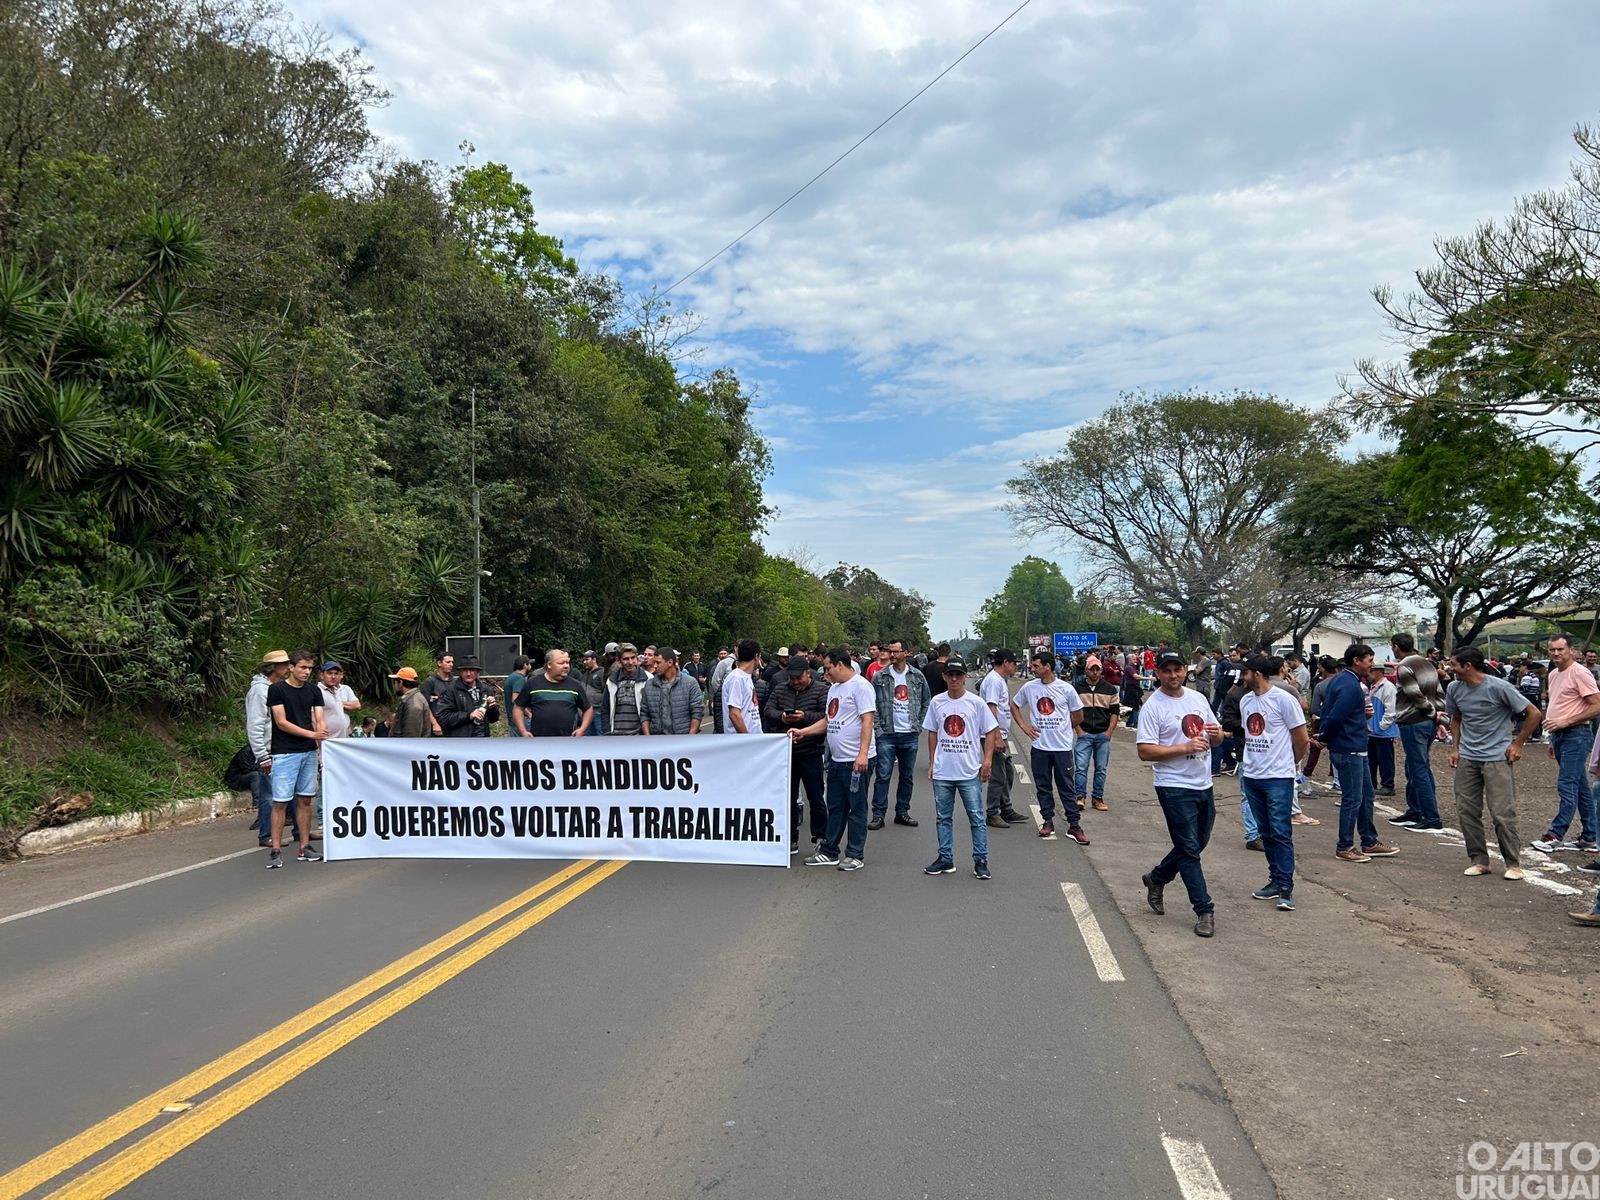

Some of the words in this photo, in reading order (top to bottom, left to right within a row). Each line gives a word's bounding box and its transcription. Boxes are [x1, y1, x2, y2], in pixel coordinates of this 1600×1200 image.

[411, 755, 460, 790] NÃO
[465, 759, 556, 791] SOMOS
[561, 758, 699, 793] BANDIDOS,
[333, 801, 366, 839] SÓ
[374, 806, 505, 841] QUEREMOS
[510, 806, 602, 838] VOLTAR
[606, 807, 623, 838] A
[628, 807, 781, 842] TRABALHAR.
